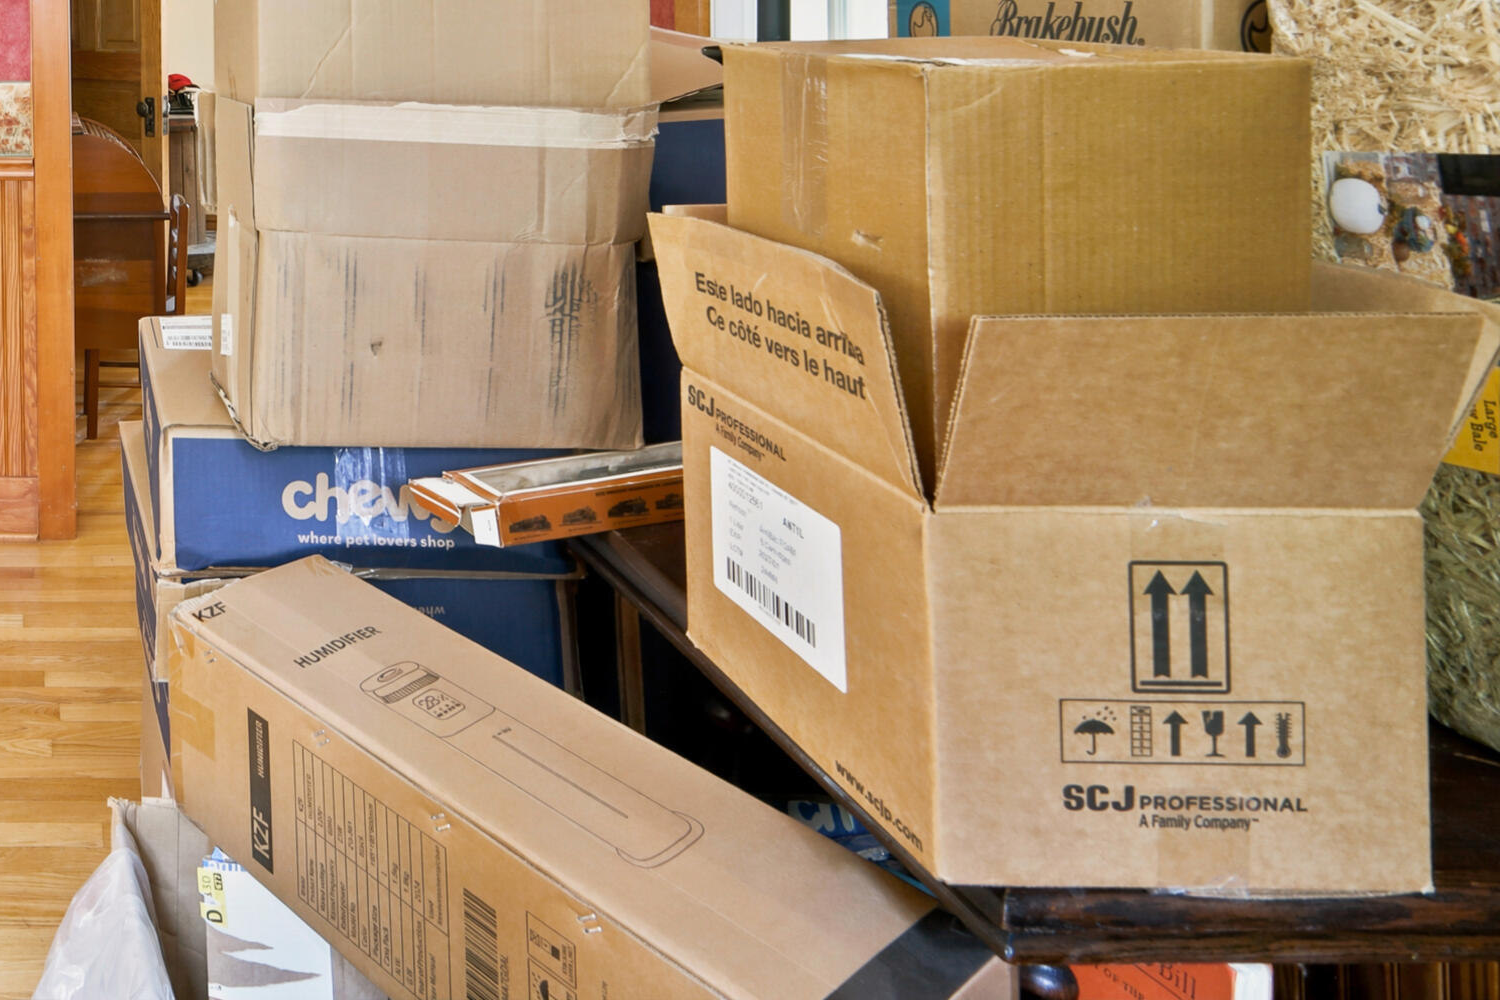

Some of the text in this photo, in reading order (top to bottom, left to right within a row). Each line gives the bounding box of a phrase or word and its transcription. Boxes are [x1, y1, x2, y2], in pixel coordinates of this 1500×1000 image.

[694, 271, 727, 301] Este
[730, 284, 763, 317] lado
[766, 299, 811, 339] hacia
[706, 305, 867, 401] Ce côté vers le haut
[687, 384, 787, 462] SCJ PROFESSIONAL
[1469, 421, 1489, 452] Bale
[1483, 399, 1499, 439] Large
[297, 530, 456, 551] where pet lovers shop
[191, 601, 228, 623] KZF
[292, 625, 382, 669] HUMIDIFIER
[255, 720, 265, 779] HUMIDIFIER
[835, 759, 924, 853] www.scjp.com
[1062, 784, 1309, 813] SCJ PROFESSIONAL
[252, 805, 270, 860] KZF
[1138, 814, 1149, 829] A
[1151, 814, 1191, 831] Family
[1103, 967, 1119, 983] OF
